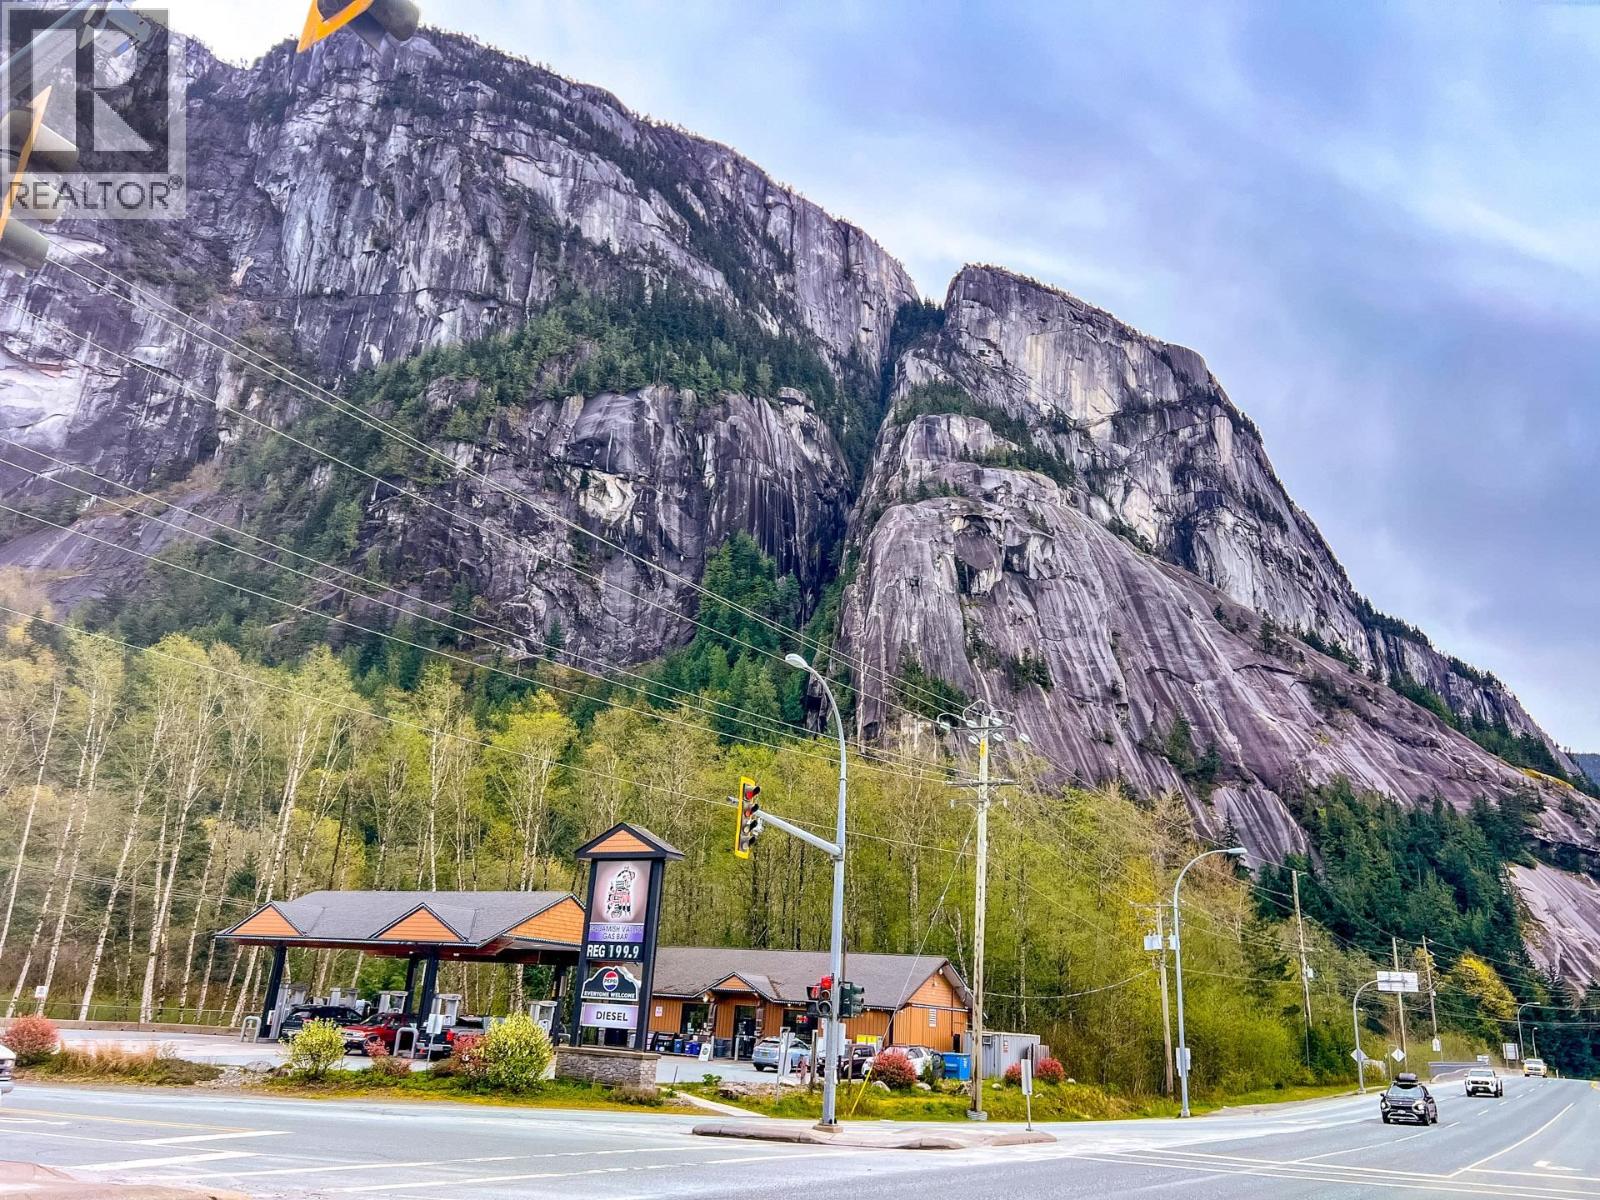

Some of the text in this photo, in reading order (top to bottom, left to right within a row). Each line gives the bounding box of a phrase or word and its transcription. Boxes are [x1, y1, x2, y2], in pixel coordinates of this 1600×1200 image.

[586, 945, 640, 959] REG 199.9
[596, 1011, 628, 1022] DIESEL
